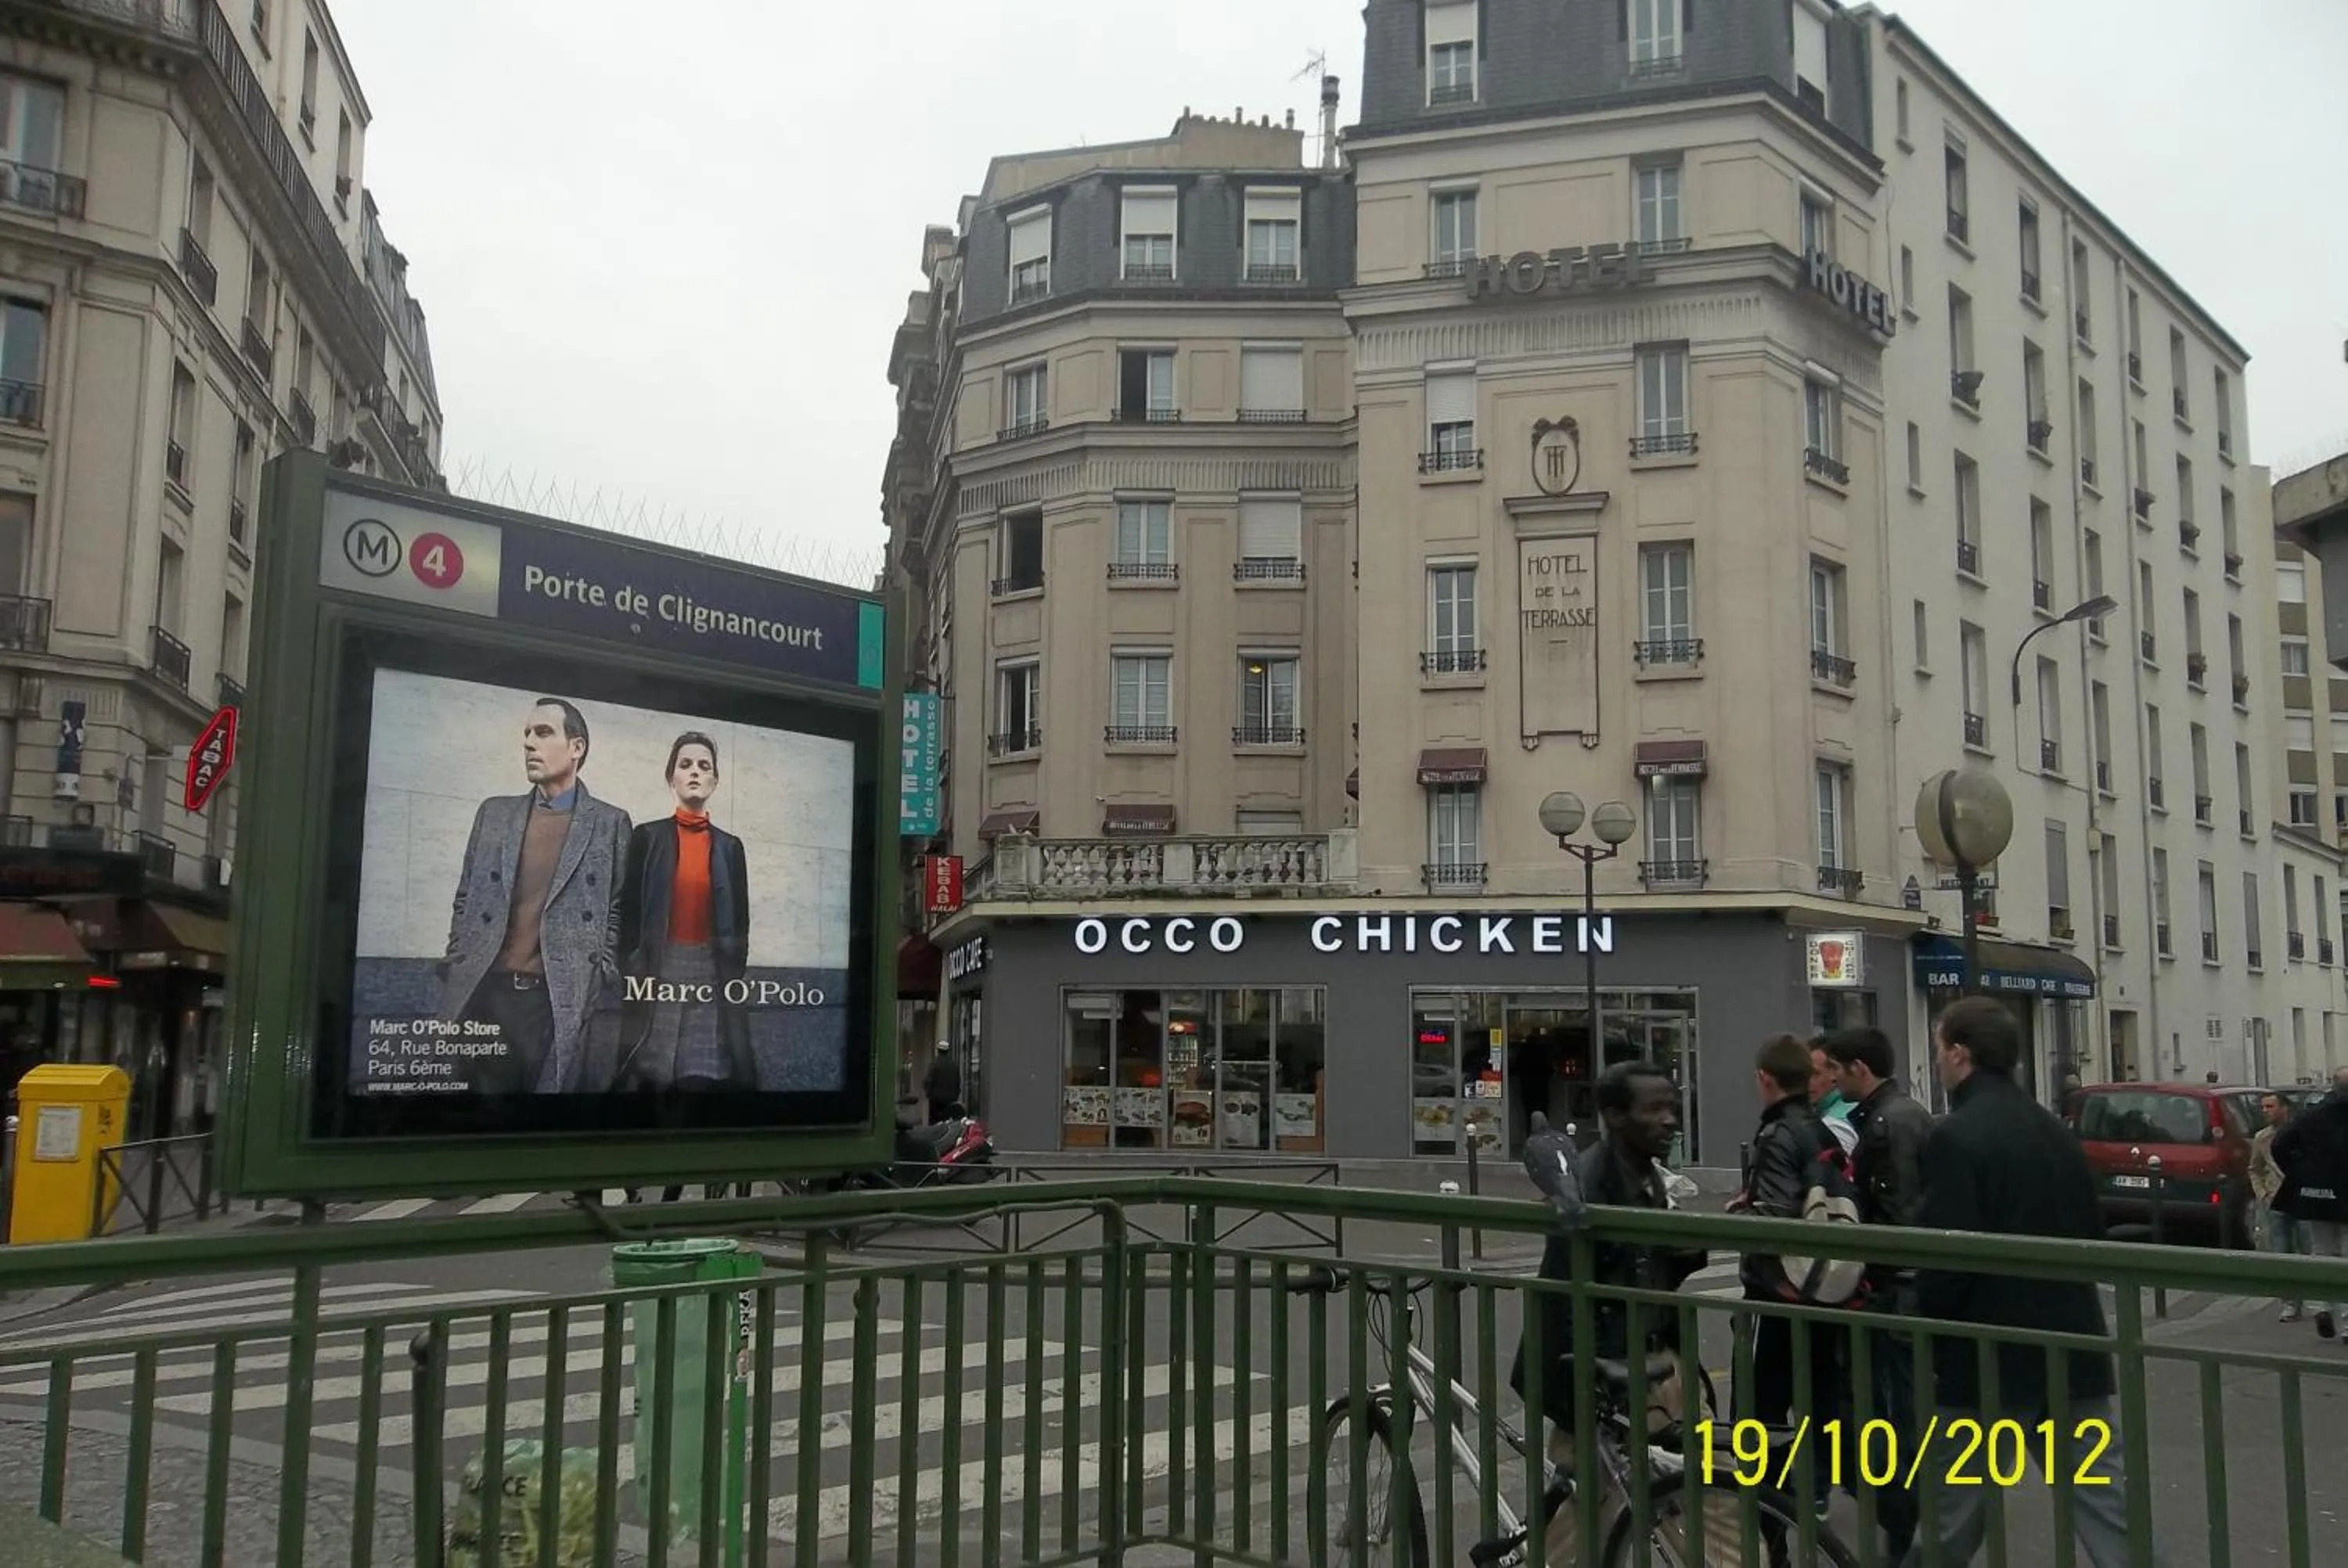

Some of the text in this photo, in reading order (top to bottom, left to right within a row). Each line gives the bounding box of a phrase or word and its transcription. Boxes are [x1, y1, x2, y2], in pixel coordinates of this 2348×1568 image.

[1464, 240, 1655, 298] HOTEL
[1805, 247, 1896, 337] HOTEL
[422, 545, 447, 577] 4
[1528, 555, 1588, 575] HOTEL
[1536, 587, 1581, 598] DE LA
[524, 564, 823, 651] Porte de Clignancourt
[1522, 607, 1595, 629] TERRASSE
[195, 728, 227, 787] TABAC
[902, 699, 920, 818] HOTEL
[924, 778, 934, 791] la
[924, 797, 935, 818] de
[936, 857, 952, 904] KEBAB
[1075, 916, 1615, 953] OCCO CHICKEN
[622, 976, 825, 1005] Marc O'Polo
[1928, 973, 1960, 986] BAR
[370, 1019, 501, 1035] Marc O'Polo Store
[369, 1040, 508, 1058] 64, Rue Bonaparte
[369, 1059, 452, 1076] Paris 6ème
[368, 1082, 469, 1092] WWW.MARC-O-POLO.COM
